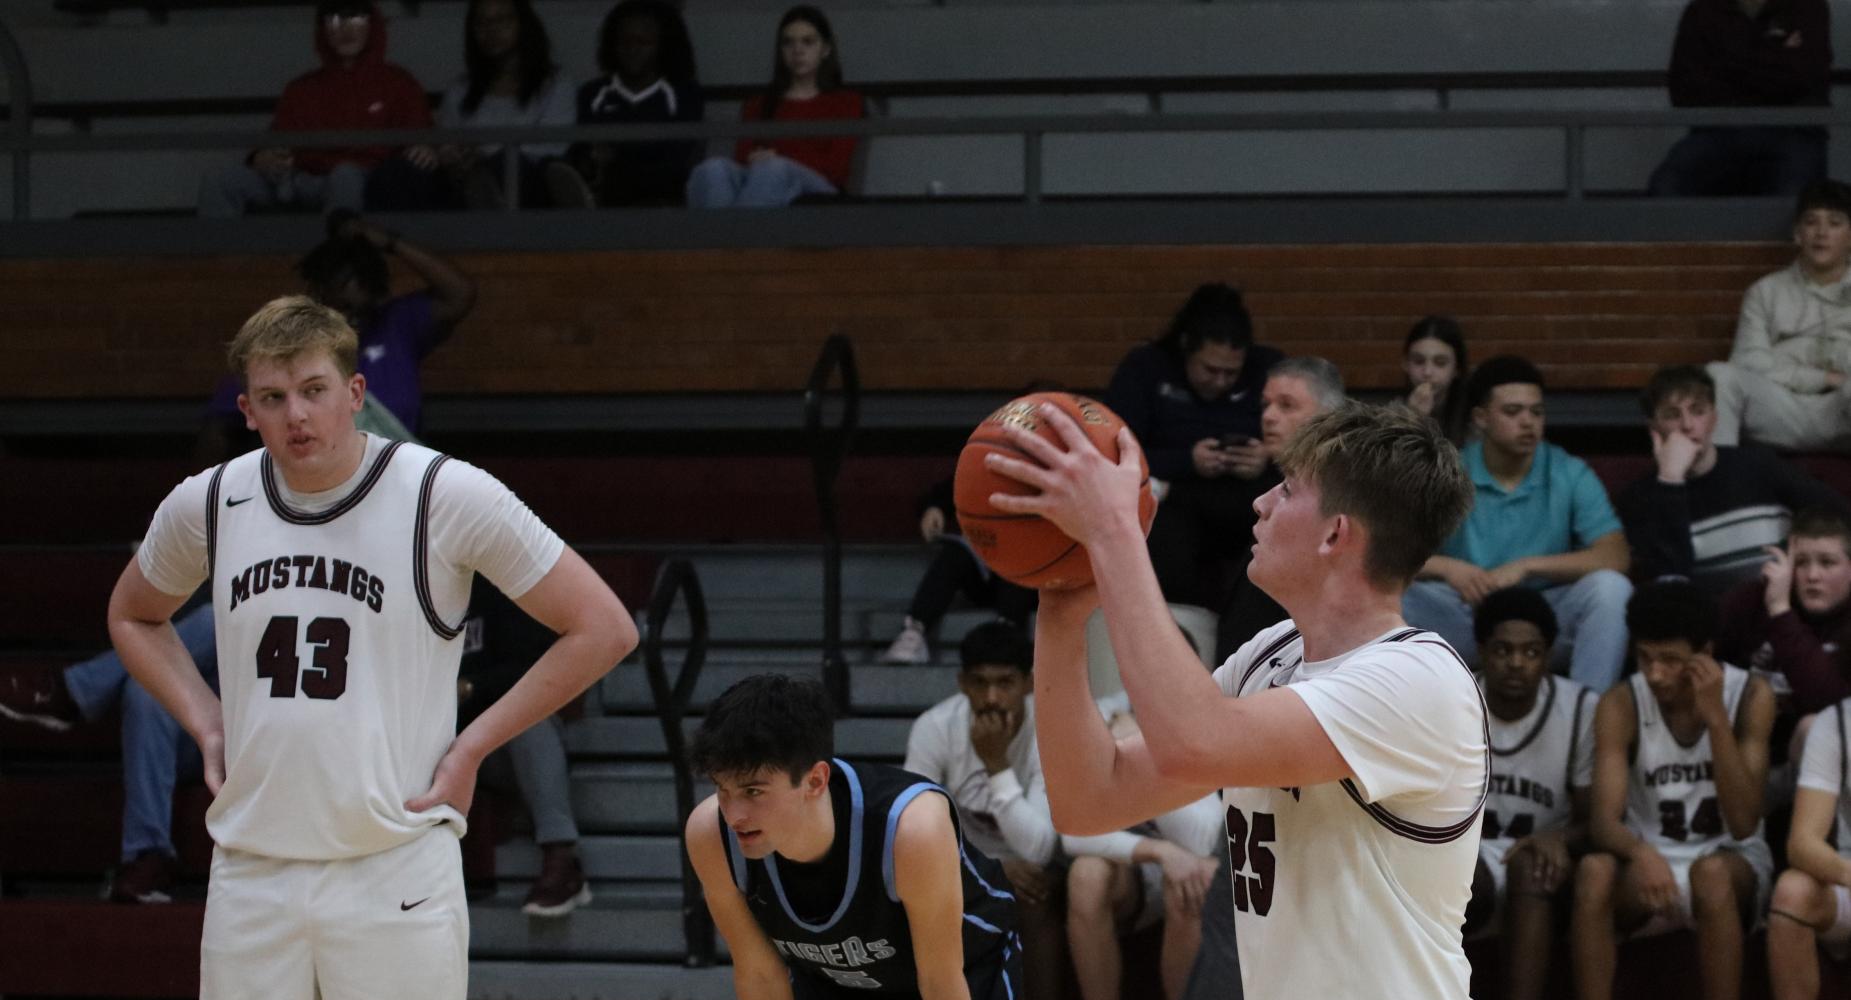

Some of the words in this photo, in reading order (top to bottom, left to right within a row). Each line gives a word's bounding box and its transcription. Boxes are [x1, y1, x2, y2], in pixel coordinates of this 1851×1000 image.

[230, 554, 385, 614] MUSTANGS
[256, 616, 351, 700] 43
[1658, 796, 1724, 842] 24
[1226, 804, 1276, 917] 25
[772, 935, 897, 968] TIGERS
